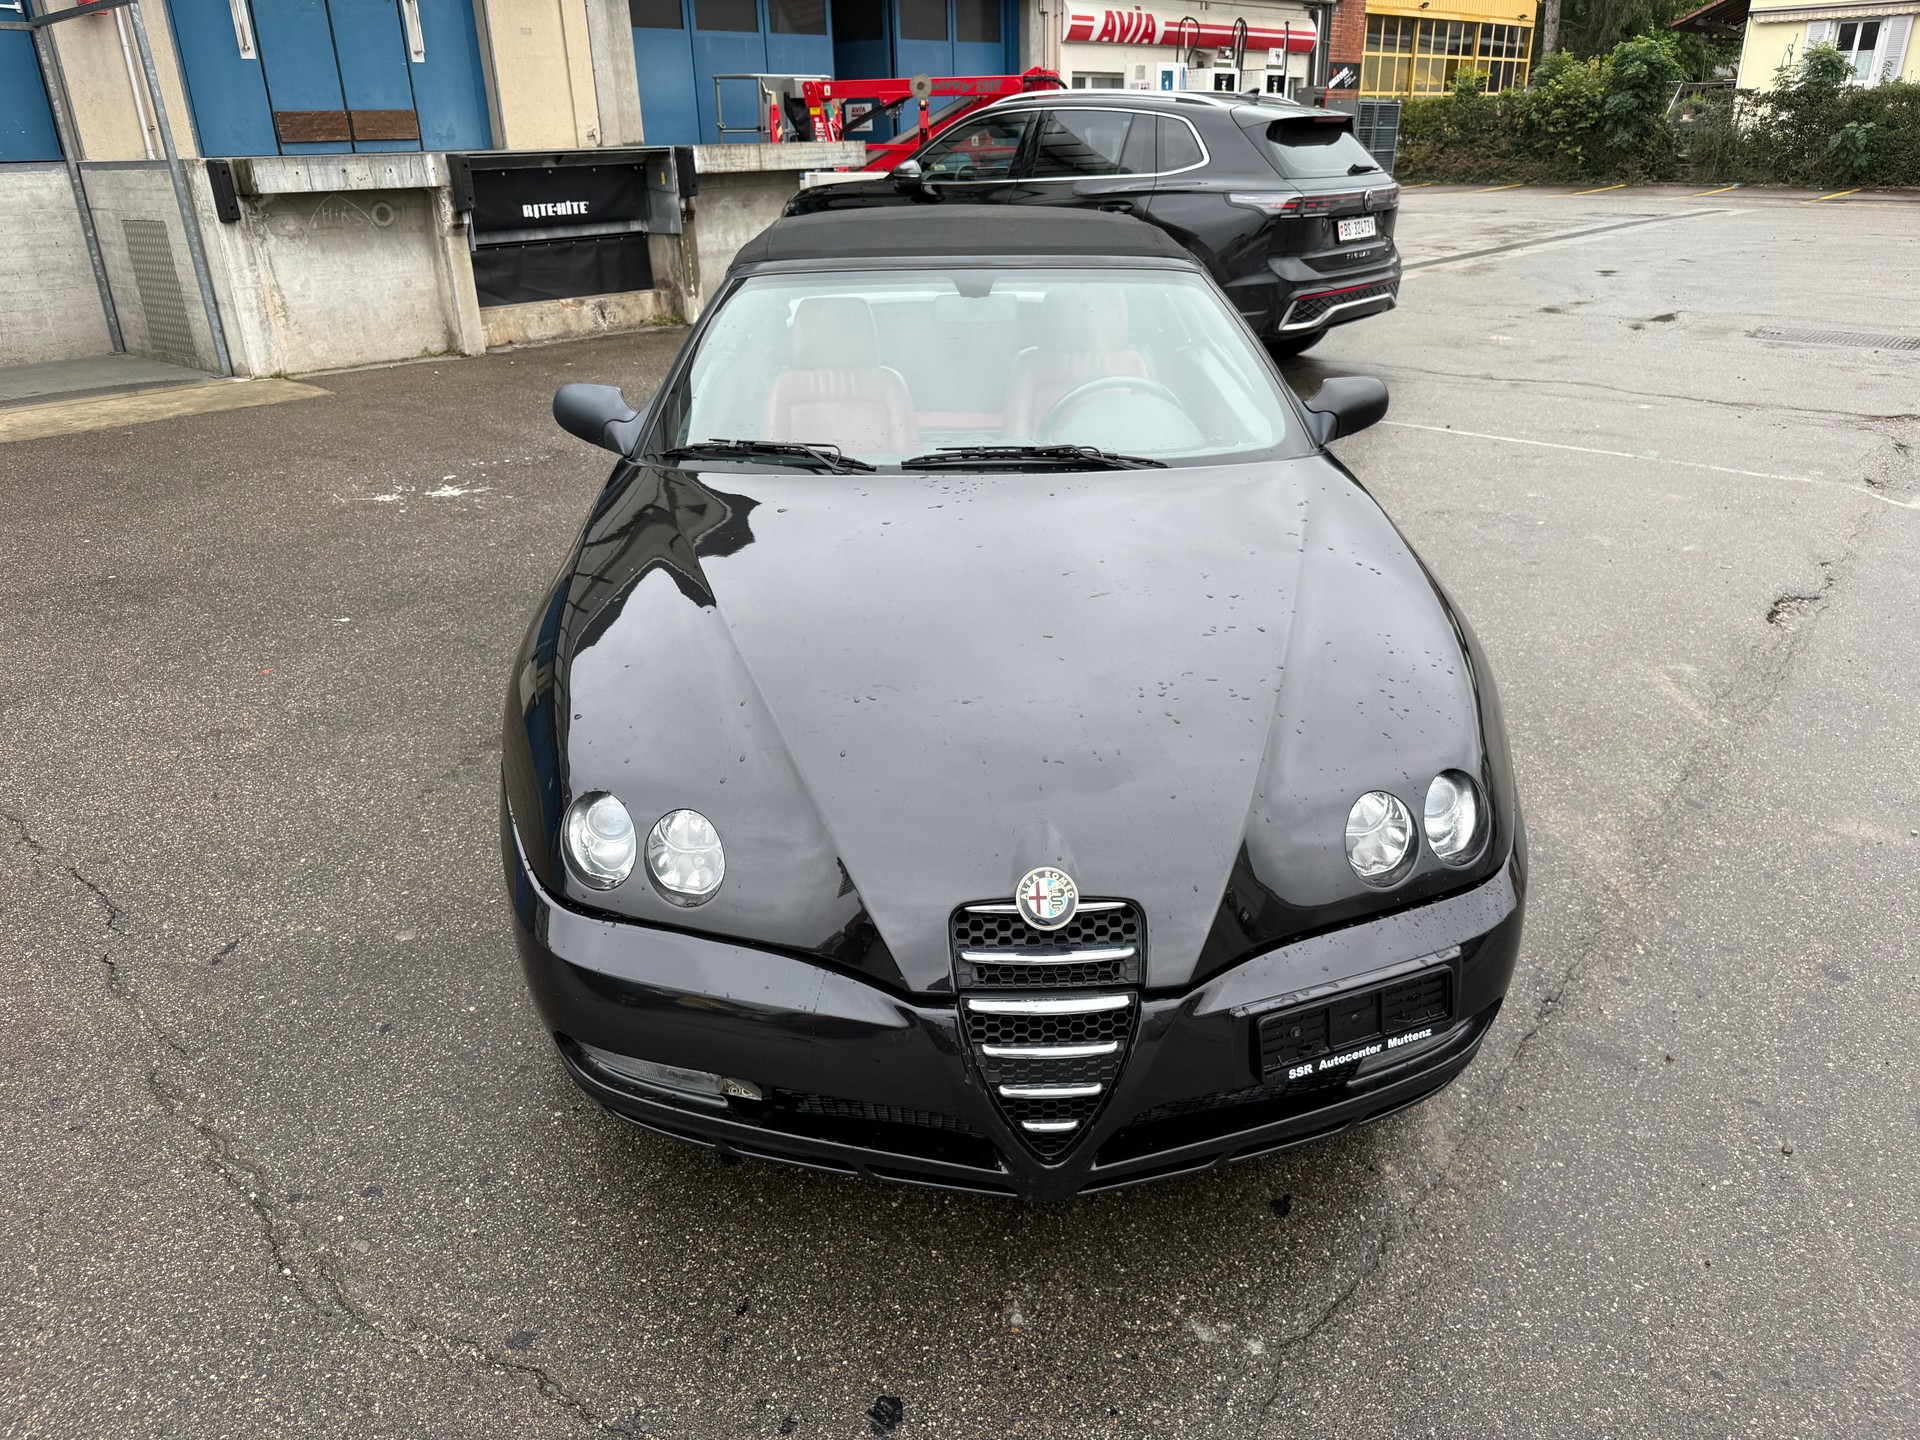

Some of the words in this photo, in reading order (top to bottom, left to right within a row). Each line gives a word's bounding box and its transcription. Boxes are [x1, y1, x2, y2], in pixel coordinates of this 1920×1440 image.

[1095, 5, 1156, 44] AVIA
[1020, 874, 1039, 900] ALFA
[1044, 871, 1075, 899] ROMEO
[1288, 1064, 1313, 1080] SSR
[1318, 1043, 1382, 1071] Autocenter
[1387, 1028, 1432, 1050] Muttenz
